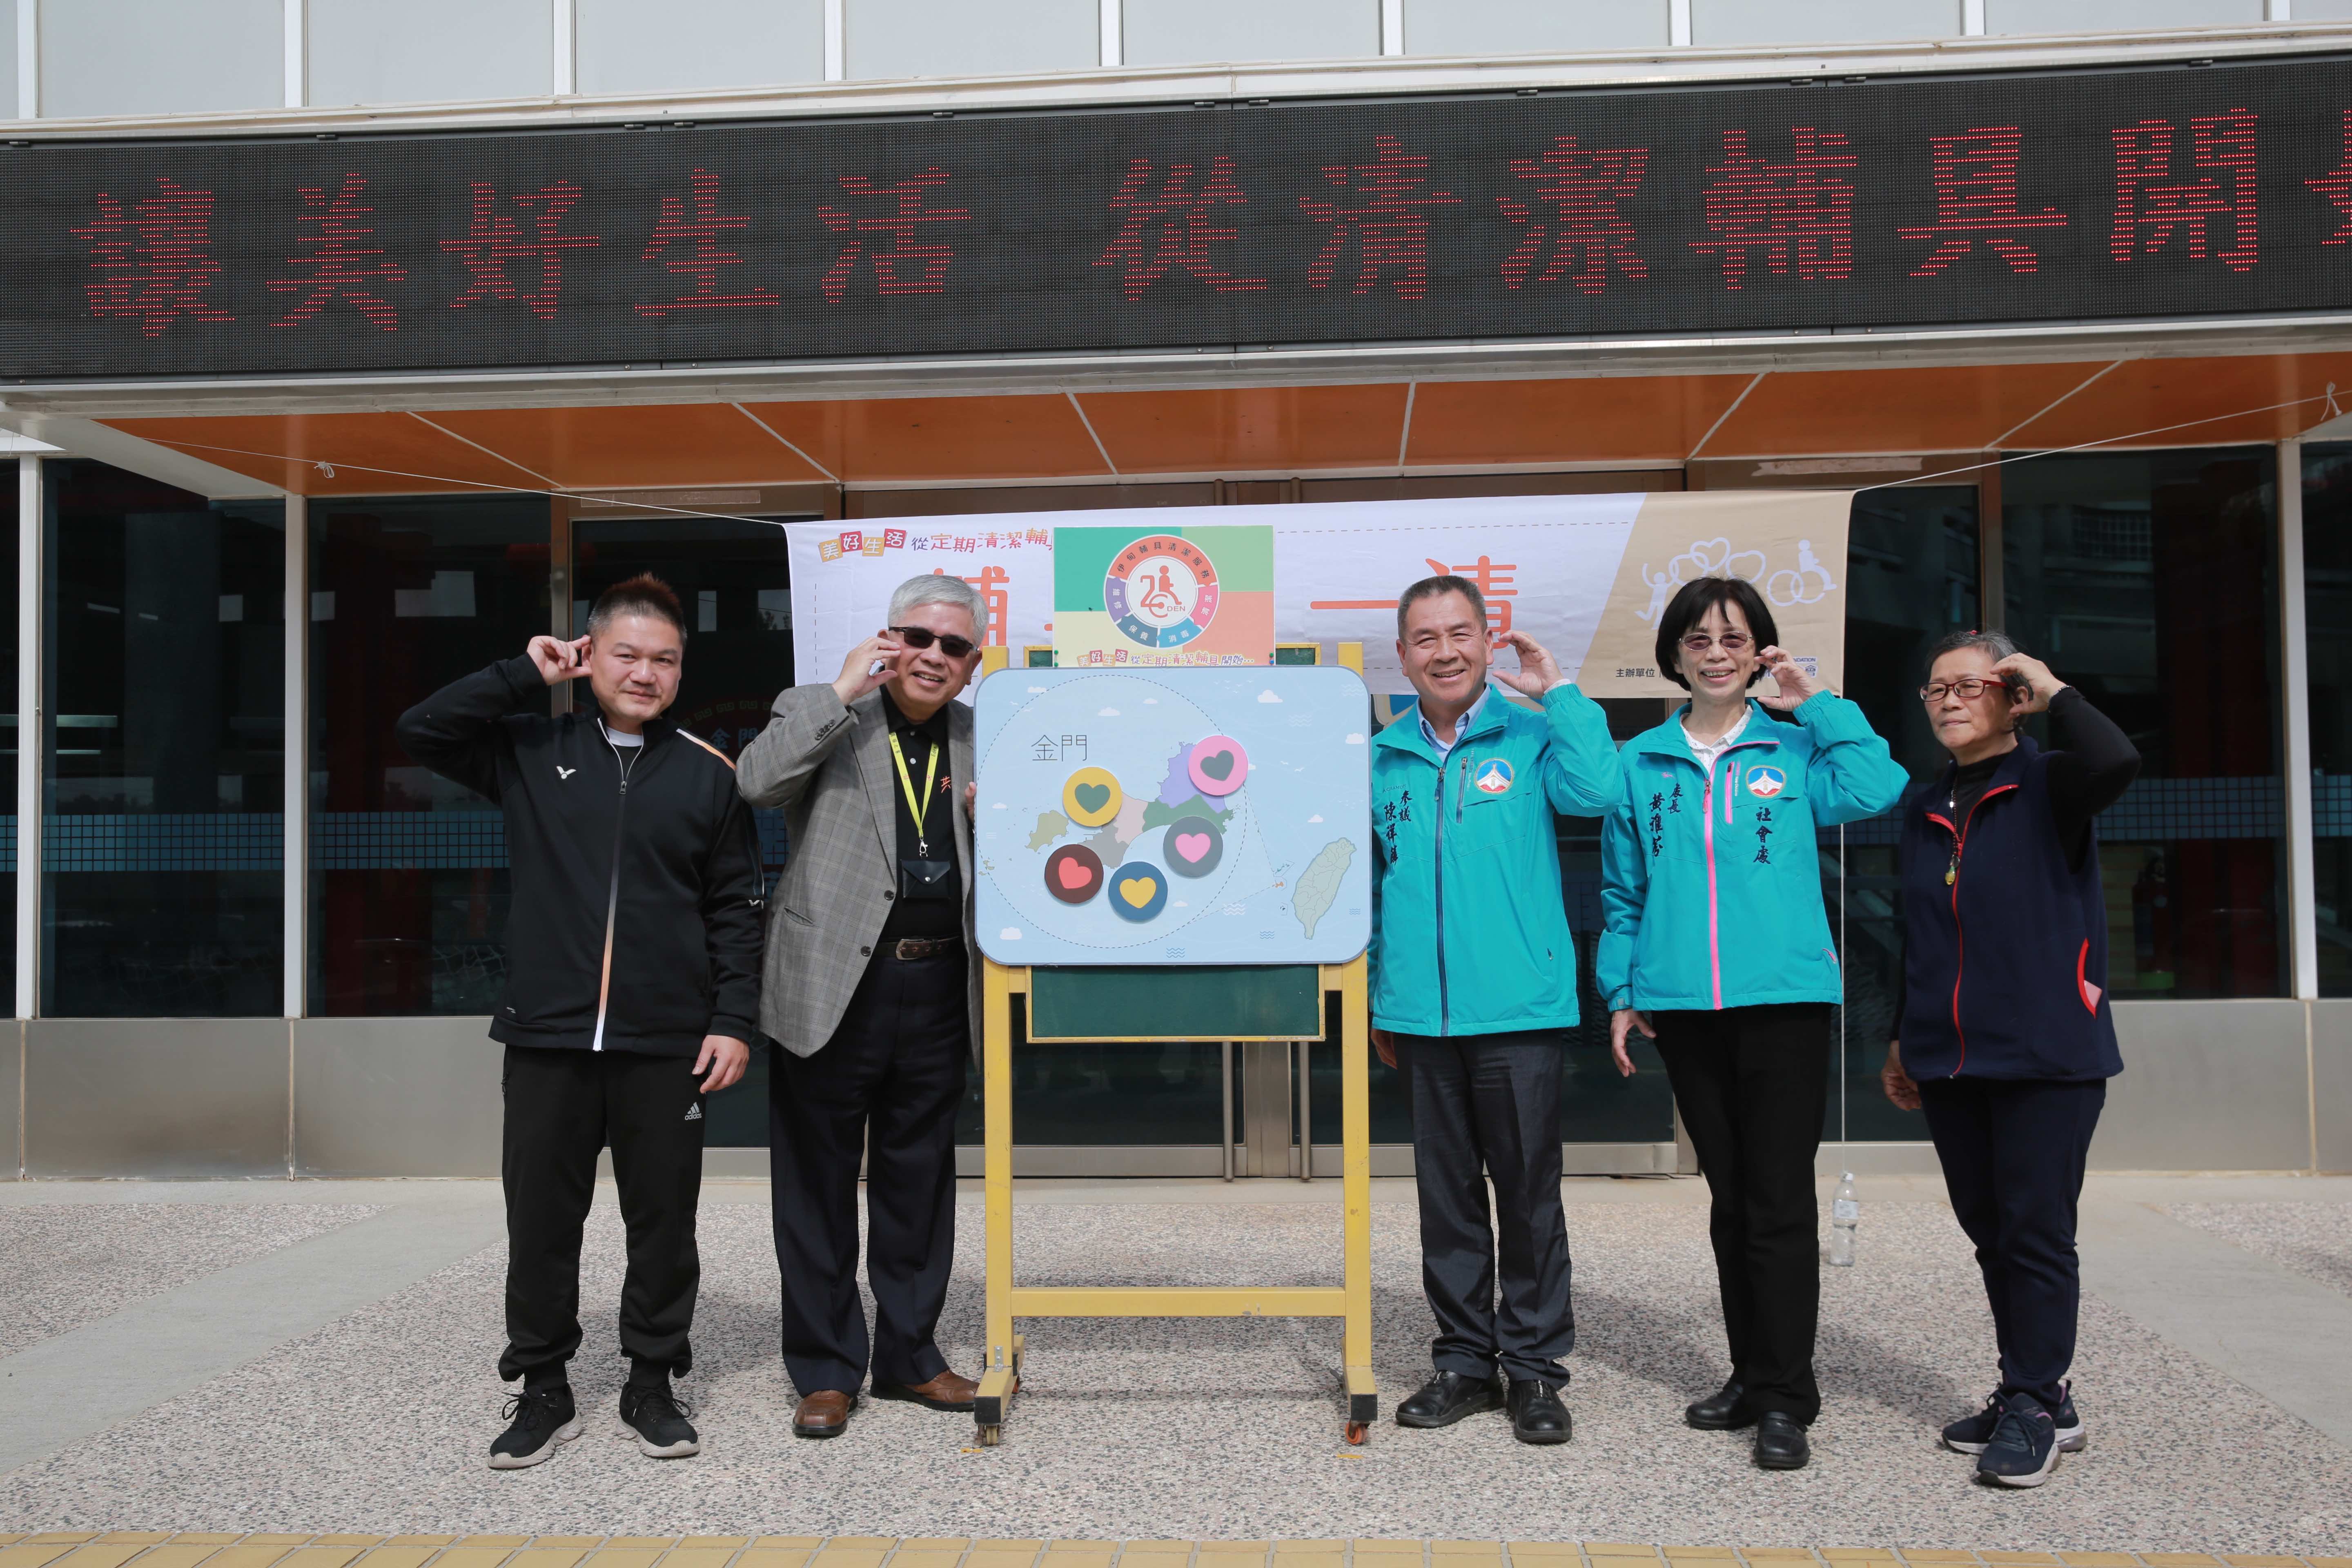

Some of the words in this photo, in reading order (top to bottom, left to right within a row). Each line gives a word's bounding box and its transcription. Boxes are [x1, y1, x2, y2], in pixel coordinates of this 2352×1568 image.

[69, 165, 971, 337] 讓美好生活
[1117, 541, 1209, 579] 伊甸輔具清潔服務
[1112, 588, 1123, 610] 維修
[1129, 624, 1149, 641] 保養
[1168, 629, 1189, 643] 消毒
[1615, 668, 1655, 678] 主辦單位
[1031, 735, 1087, 762] 金門
[1753, 806, 1773, 865] 社會處
